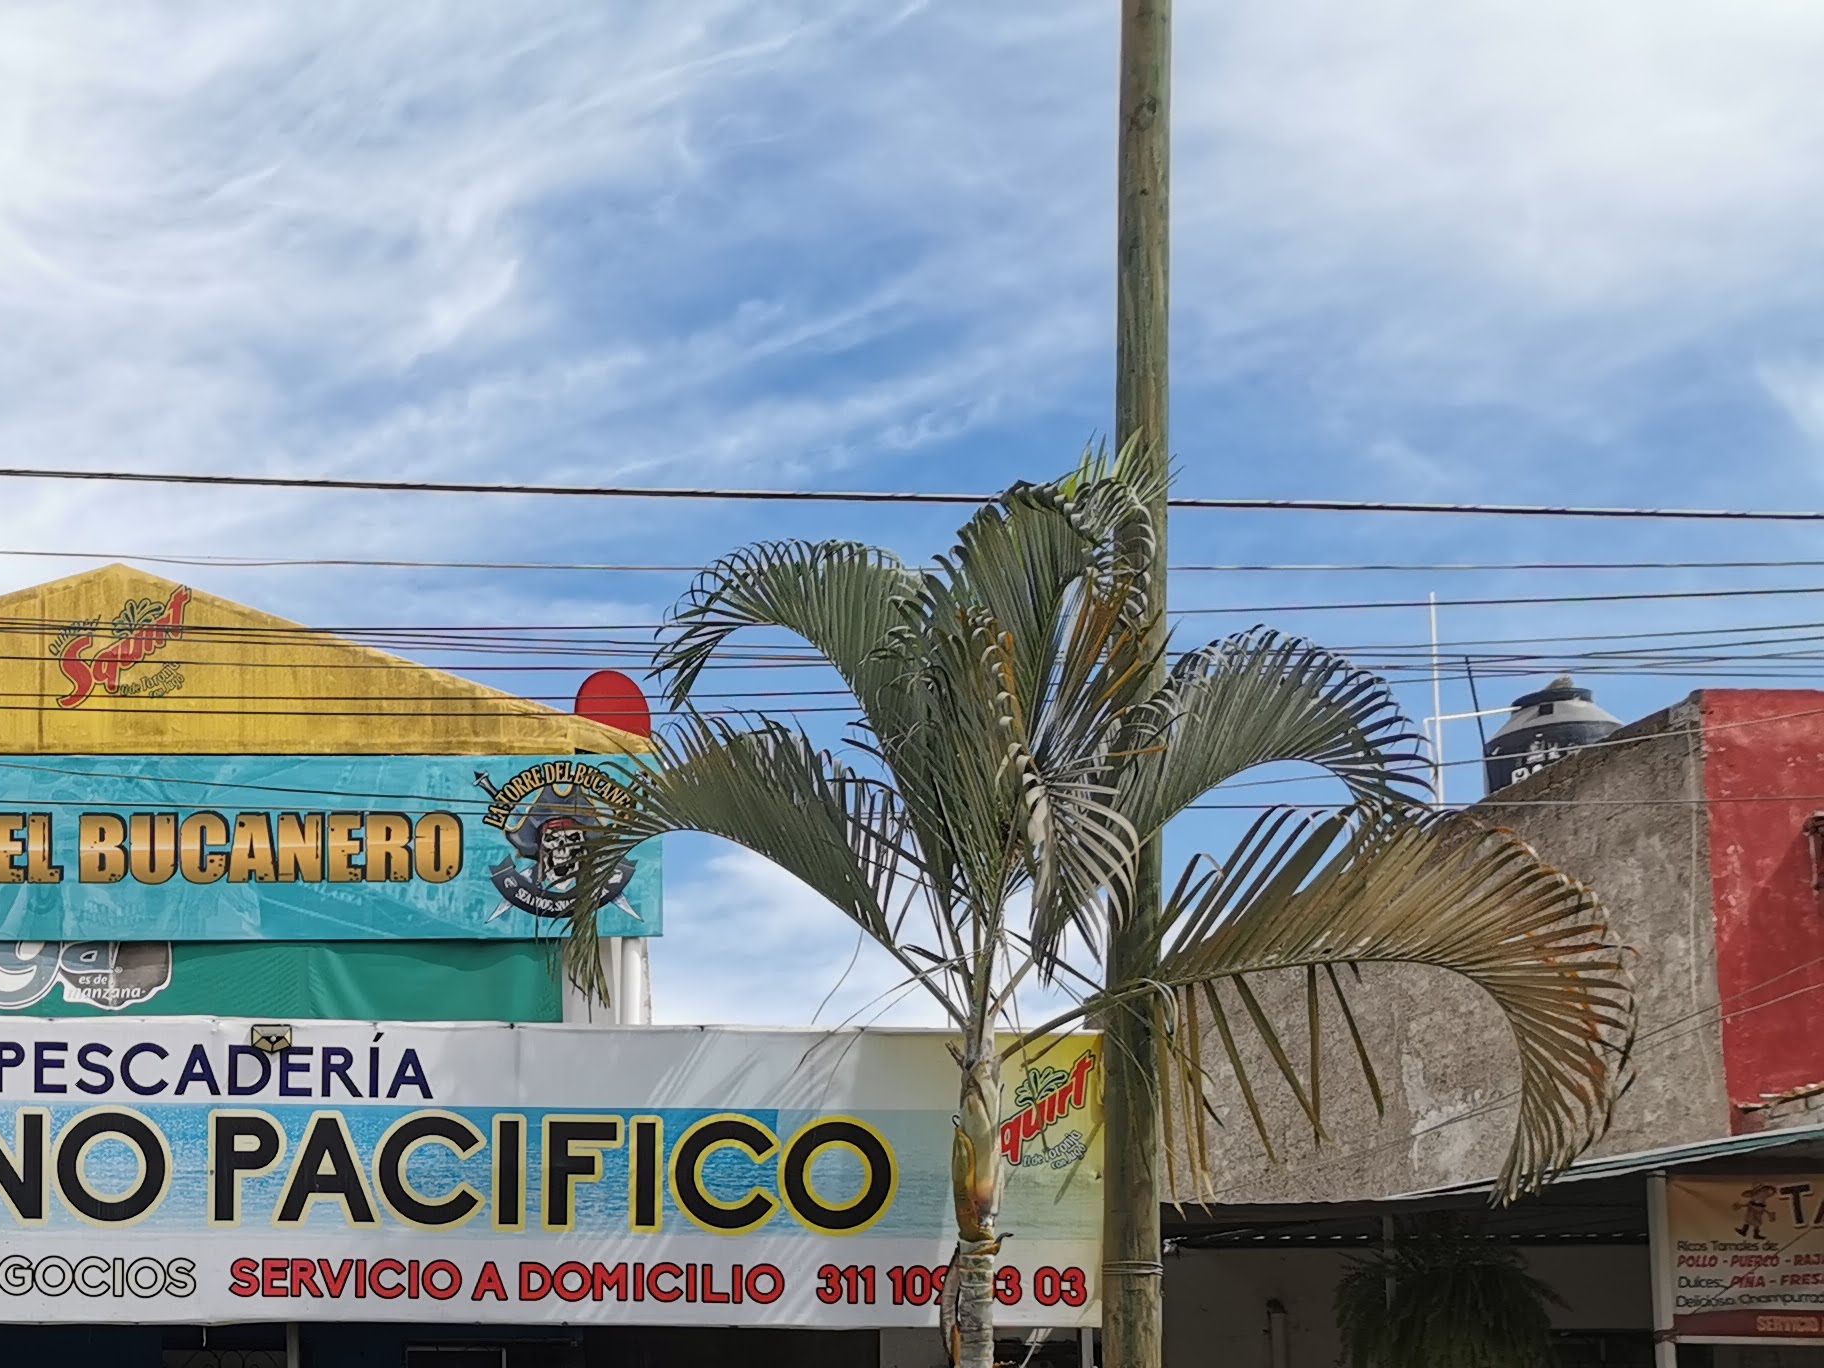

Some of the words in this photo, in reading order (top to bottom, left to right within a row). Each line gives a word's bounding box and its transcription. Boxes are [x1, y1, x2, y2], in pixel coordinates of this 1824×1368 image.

[56, 584, 192, 708] Squirt
[494, 767, 545, 809] TORRE
[542, 761, 574, 784] DEL
[78, 810, 464, 885] BUCANERO
[78, 974, 91, 985] es
[93, 973, 109, 985] de
[999, 1049, 1097, 1167] quirt
[214, 1112, 893, 1230] PACIFICO
[228, 1257, 463, 1301] SERVICIO
[470, 1260, 509, 1302] A
[518, 1260, 785, 1306] DOMICILIO
[815, 1263, 876, 1305] 311
[1033, 1266, 1088, 1307] 03
[1676, 1254, 1719, 1268] POLLO
[1779, 1273, 1824, 1286] FRES
